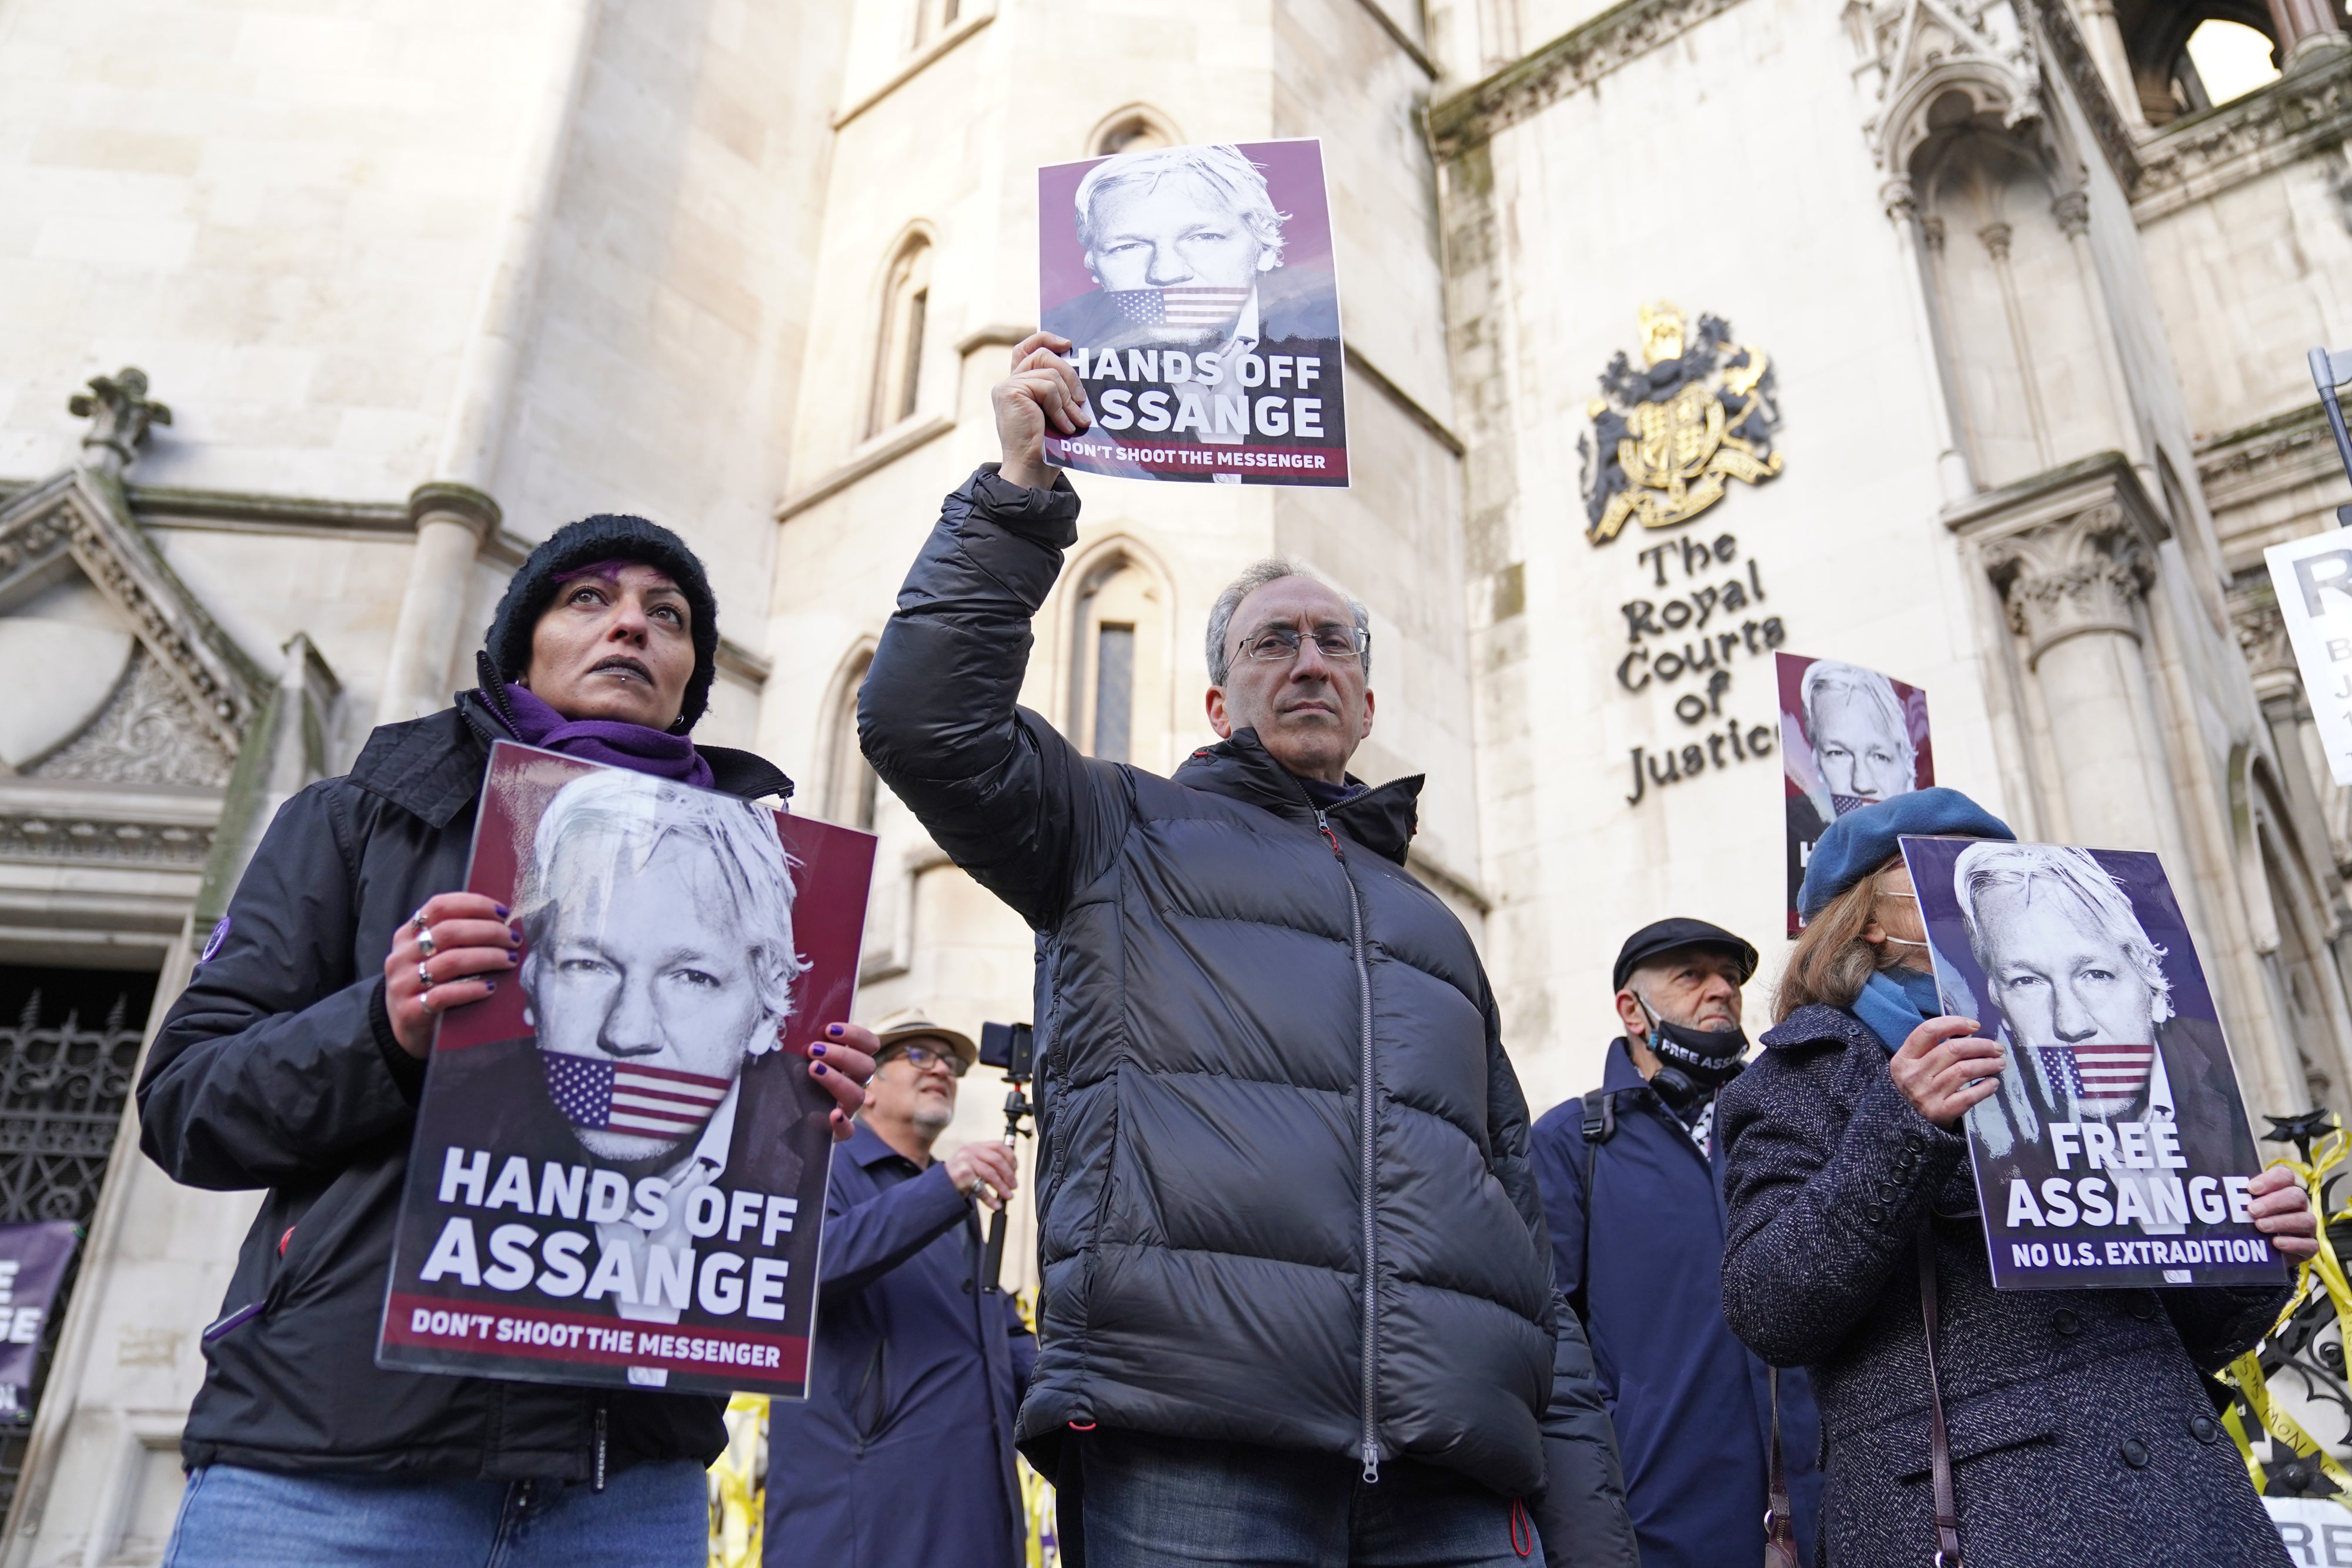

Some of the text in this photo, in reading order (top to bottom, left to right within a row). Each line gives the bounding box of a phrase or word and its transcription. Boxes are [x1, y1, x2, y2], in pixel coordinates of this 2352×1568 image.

[1235, 352, 1321, 390] OFF
[1060, 439, 1325, 469] DON'T SHOOT THE MESSENGER
[1638, 532, 1737, 587] The
[1621, 558, 1766, 643] Royal
[1616, 616, 1786, 694] Courts
[1674, 669, 1732, 726] of
[1626, 718, 1780, 807] Justic
[1661, 1038, 1700, 1065] FREE
[2049, 1122, 2187, 1170] FREE
[437, 1146, 798, 1247] HANDS OFF
[2006, 1176, 2256, 1228] ASSANGE
[420, 1216, 789, 1321] ASSANGE
[2011, 1239, 2269, 1268] NO U.S. EXTRADITION
[412, 1308, 780, 1368] DON'T SHOOT THE MESSENGER
